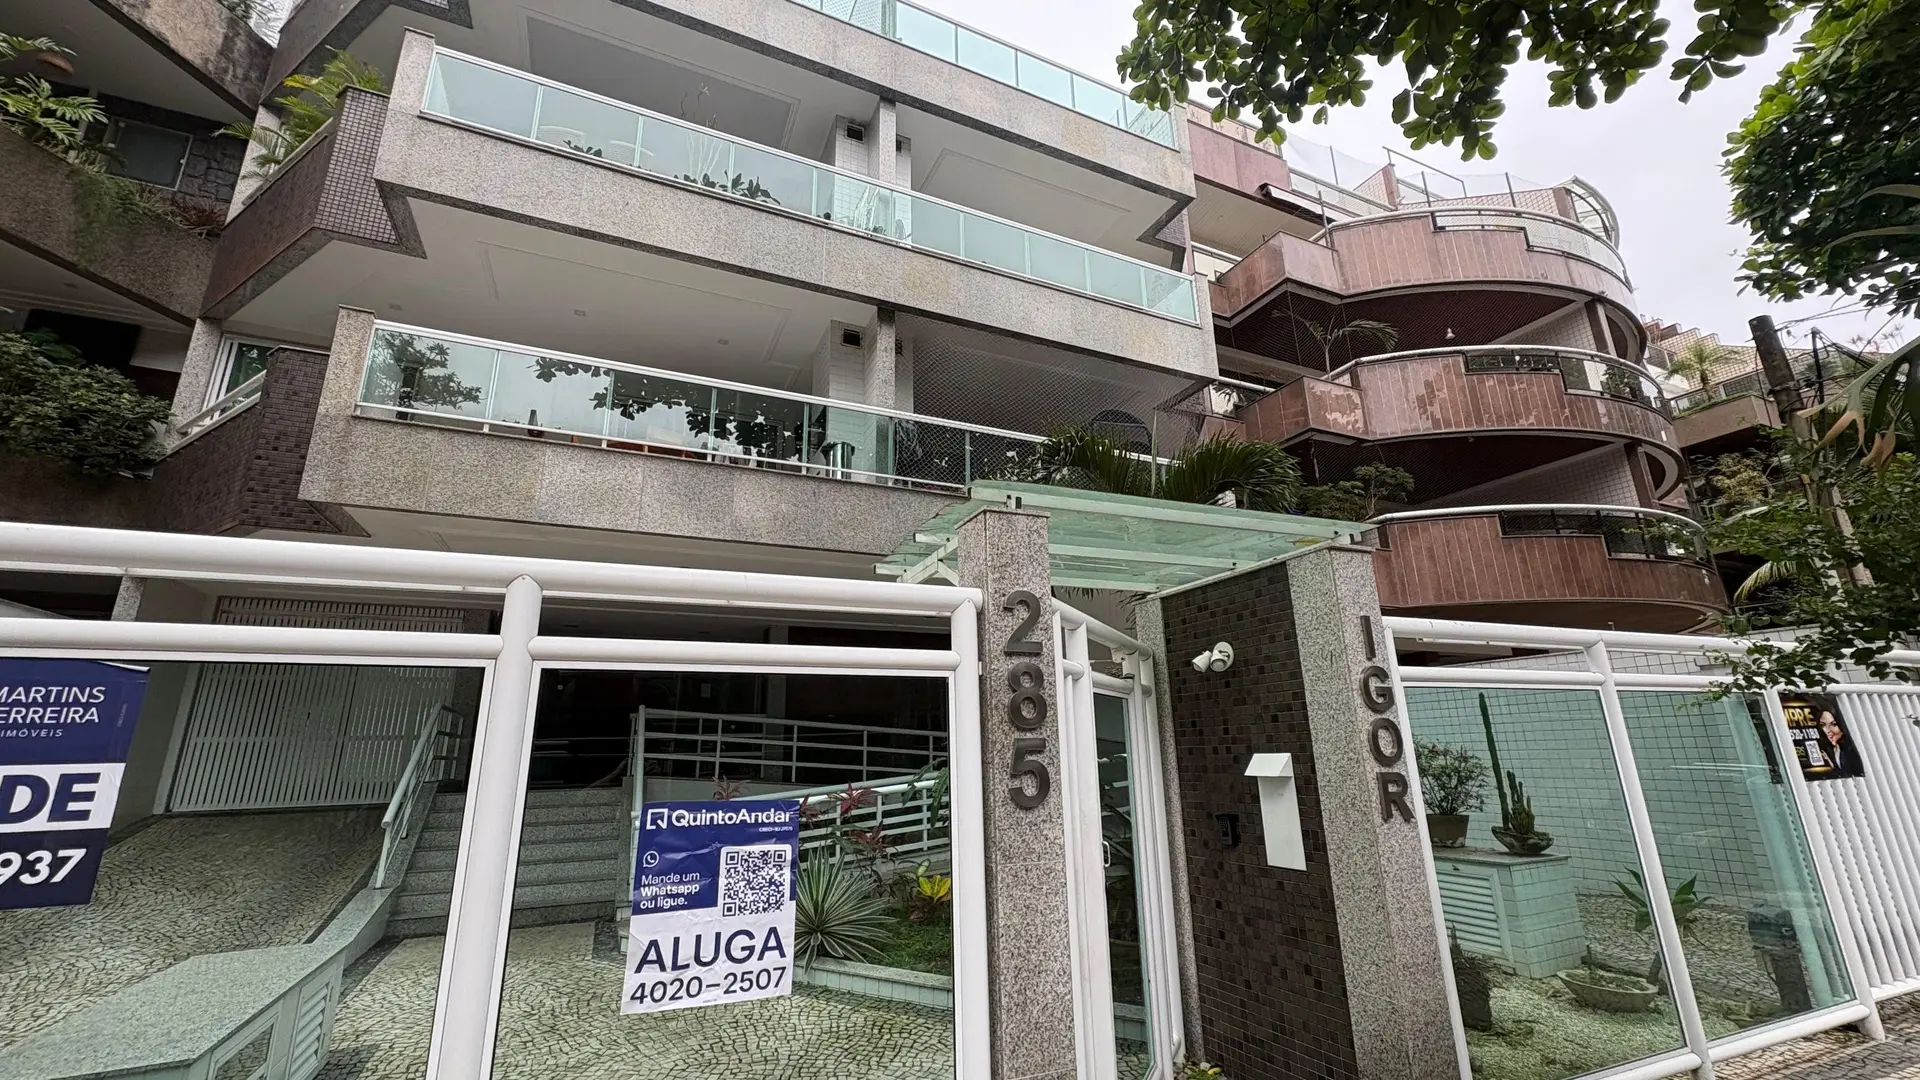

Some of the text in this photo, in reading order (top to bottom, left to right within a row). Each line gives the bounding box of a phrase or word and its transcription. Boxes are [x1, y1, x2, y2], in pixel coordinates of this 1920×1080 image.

[1003, 590, 1050, 808] 285
[1, 728, 63, 737] IMÓVEIS
[1359, 615, 1416, 822] IGOR
[0, 772, 101, 824] DE
[672, 808, 793, 827] QuintoAndar
[0, 849, 87, 885] 937
[641, 872, 700, 885] Mande um
[640, 883, 700, 897] Whatsapp
[640, 896, 688, 910] ou ligue.
[634, 926, 787, 974] ALUGA
[630, 967, 787, 1004] 4020-2507
